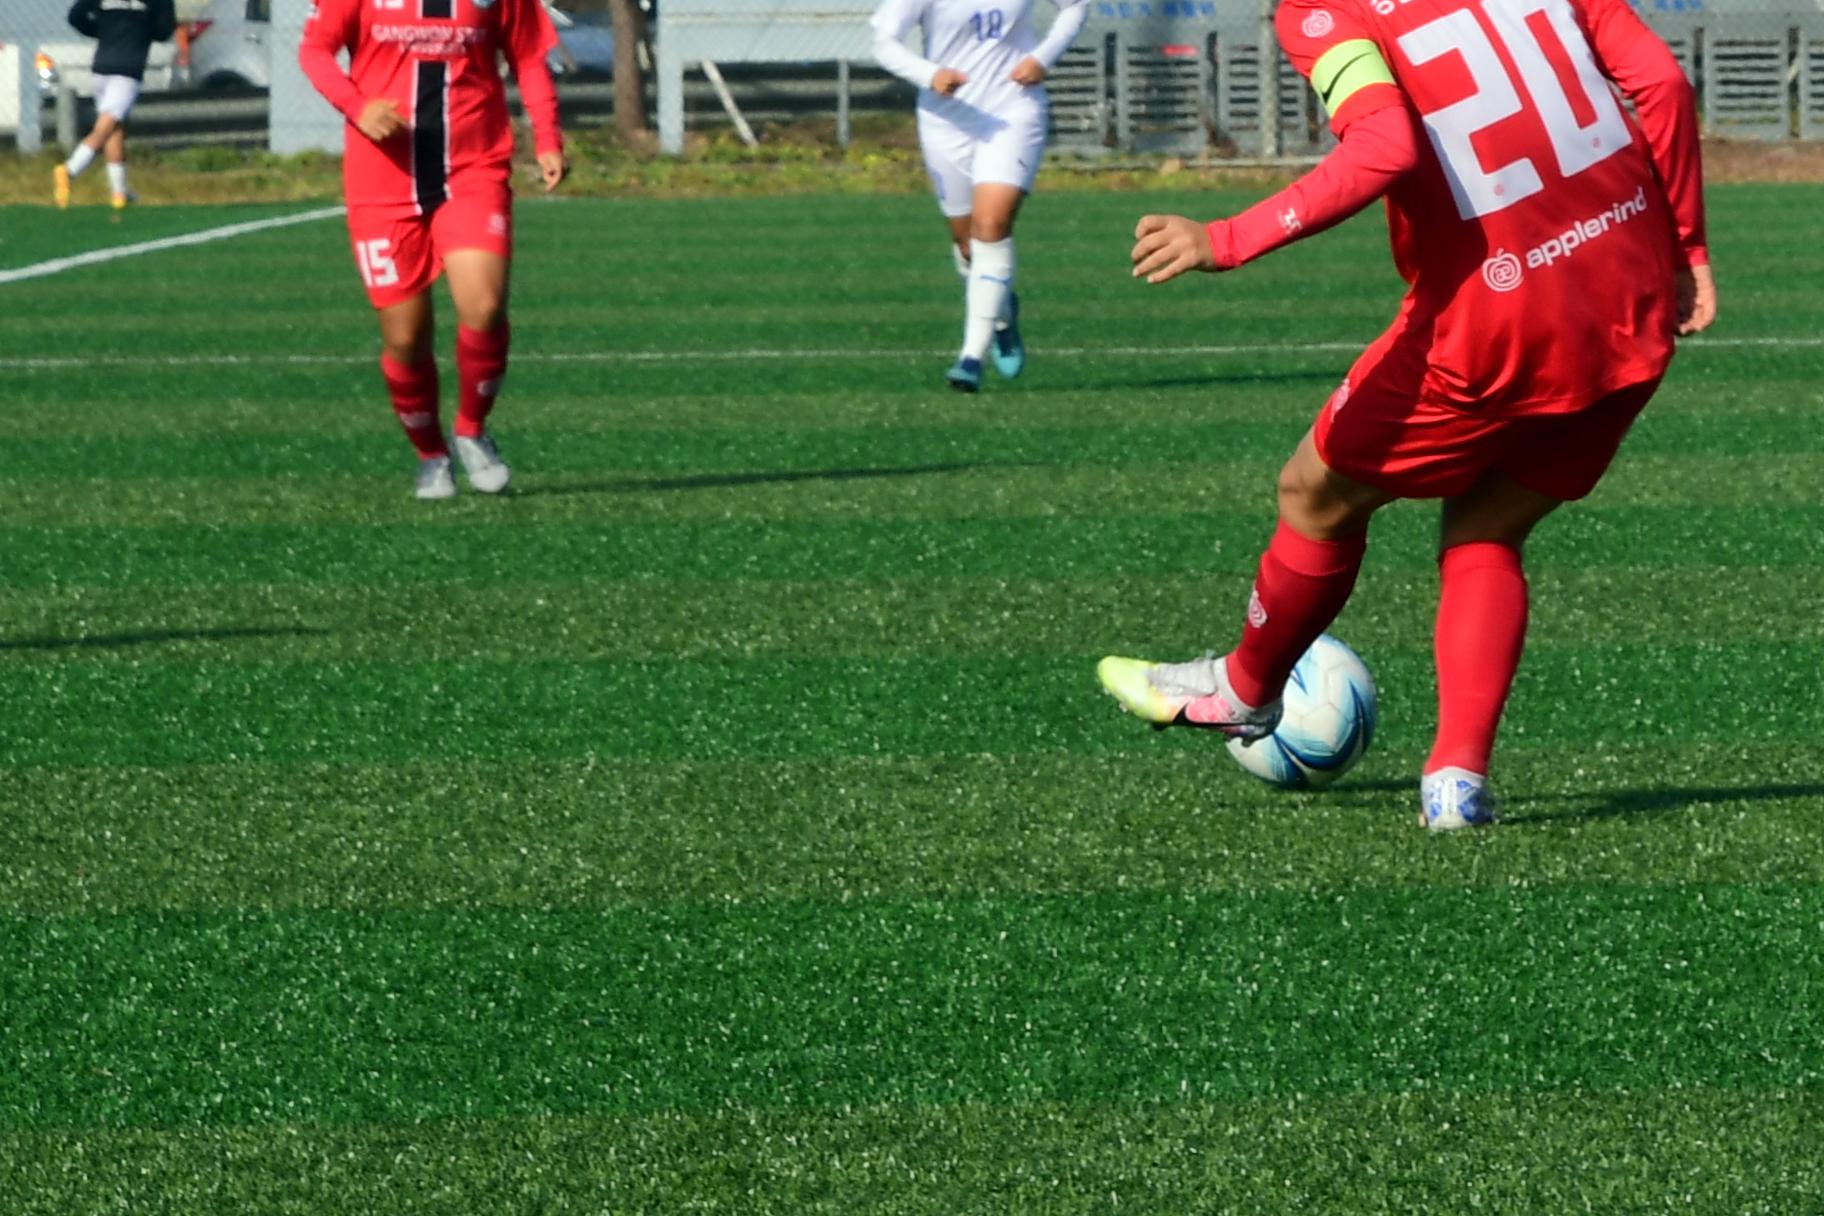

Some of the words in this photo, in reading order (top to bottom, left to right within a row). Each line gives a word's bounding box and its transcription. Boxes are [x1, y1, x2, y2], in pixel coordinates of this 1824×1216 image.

[968, 7, 1004, 43] 18
[1525, 186, 1647, 269] applerind
[356, 237, 400, 288] 15
